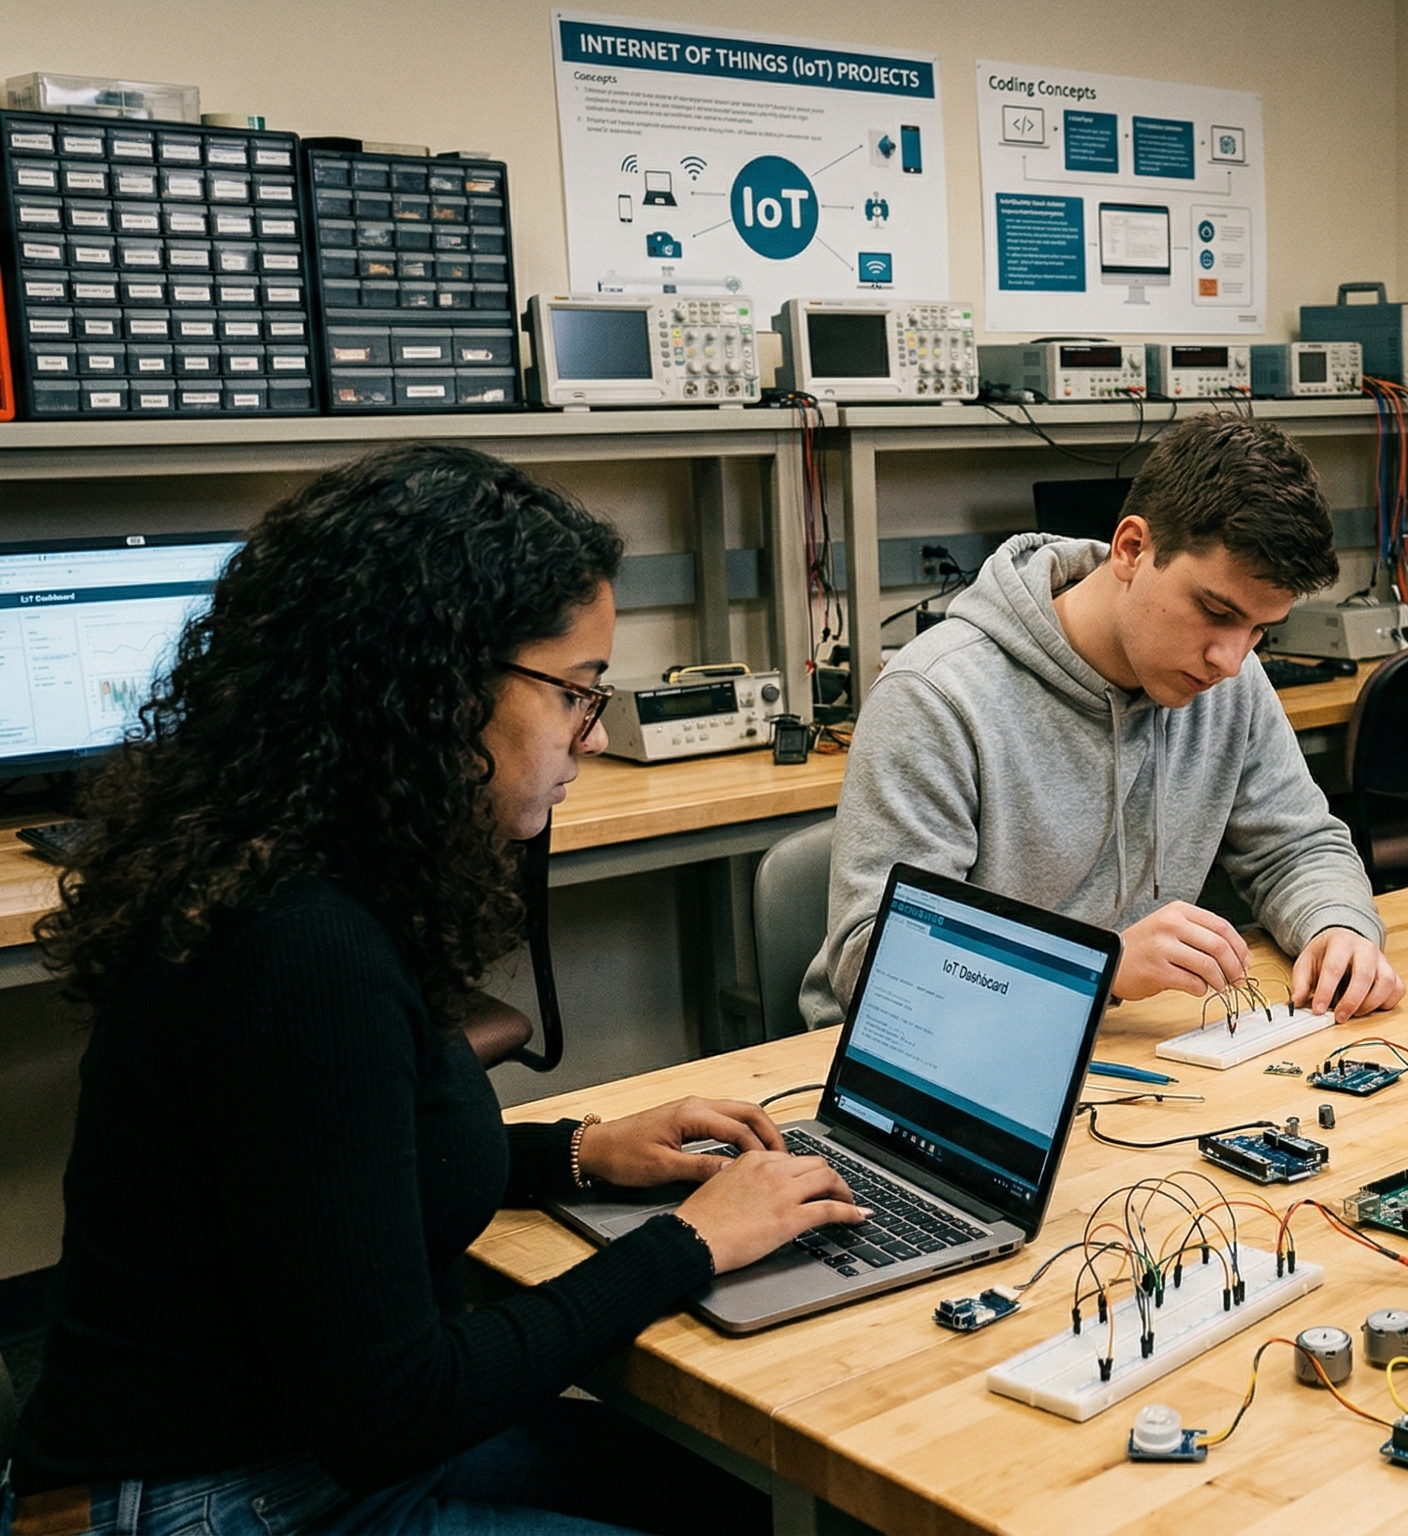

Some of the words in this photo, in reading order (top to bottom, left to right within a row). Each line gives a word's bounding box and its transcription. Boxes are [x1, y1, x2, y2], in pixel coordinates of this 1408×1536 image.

[580, 34, 680, 62] INTERNET
[685, 45, 711, 65] OF
[715, 48, 788, 74] THINGS
[792, 55, 833, 82] (IoT)
[837, 62, 920, 88] PROJECTS
[988, 75, 1035, 97] Coding
[1037, 80, 1097, 102] Concepts
[743, 186, 809, 229] IoT
[942, 959, 960, 976] IoT
